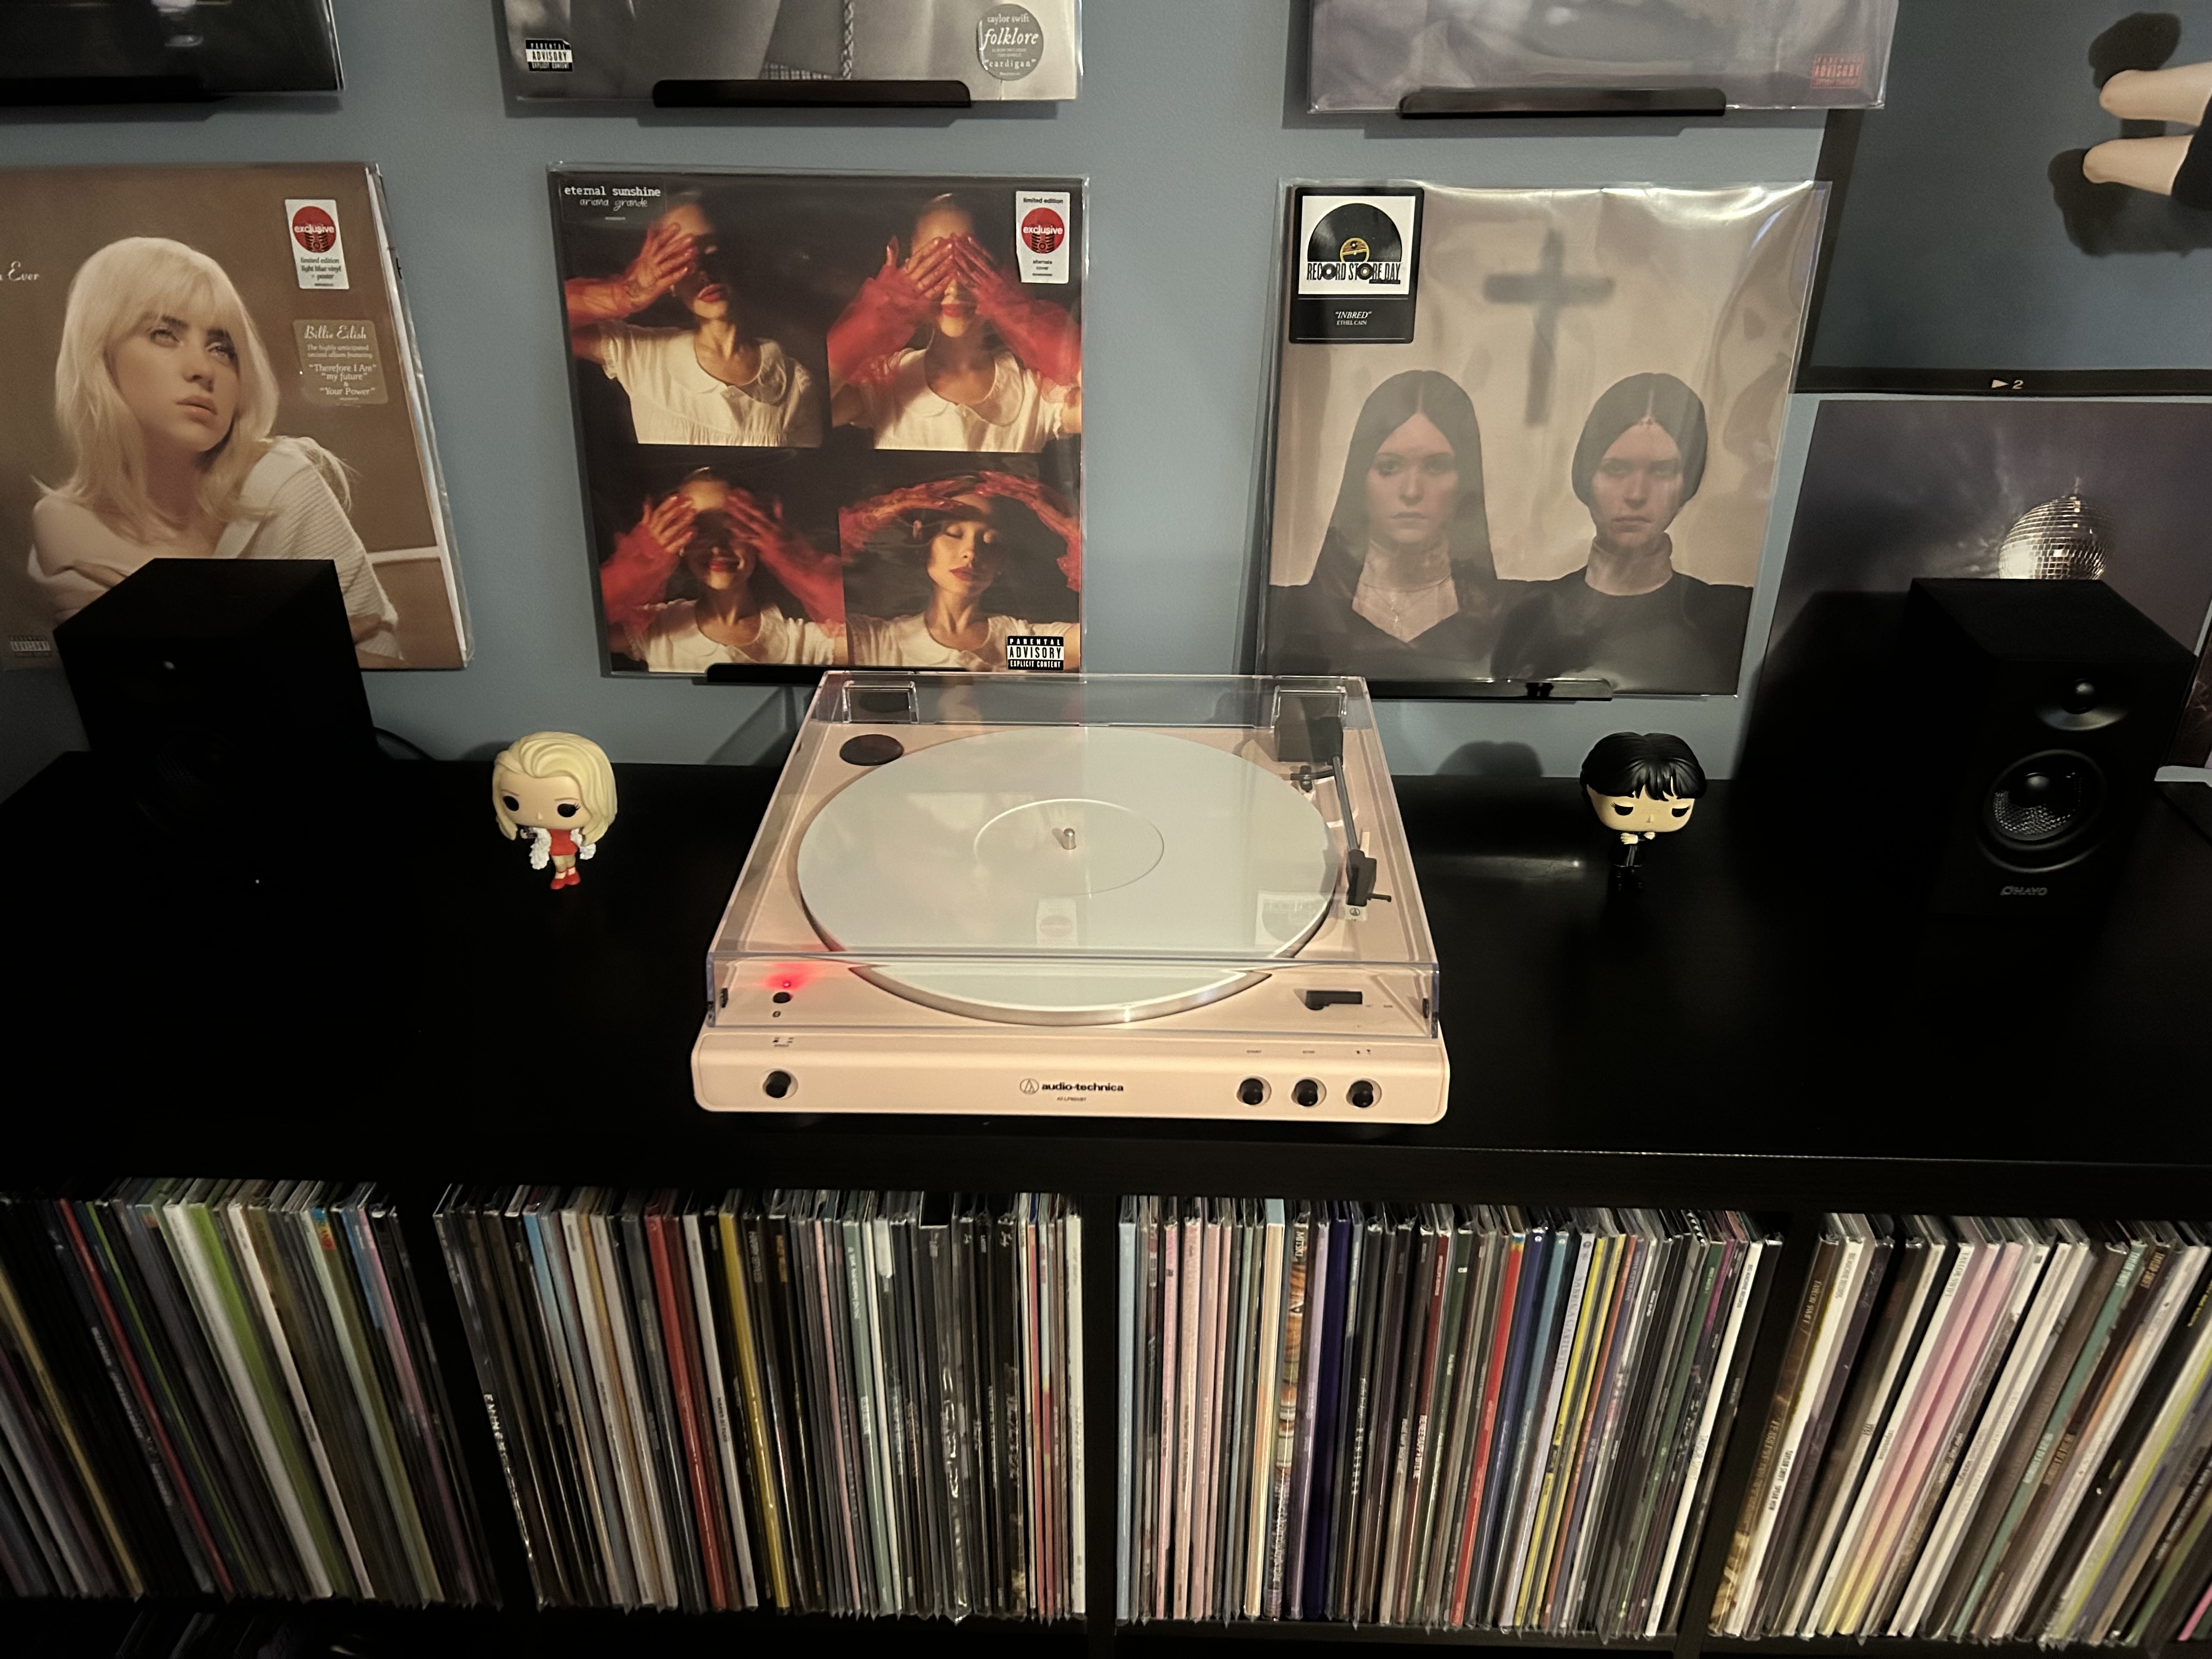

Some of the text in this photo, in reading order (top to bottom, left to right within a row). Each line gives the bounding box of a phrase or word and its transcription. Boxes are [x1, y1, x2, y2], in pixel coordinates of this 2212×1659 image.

[988, 13, 1029, 25] taylor swift
[979, 27, 1039, 50] folklore
[532, 50, 566, 61] ADVISORY
[565, 186, 661, 196] eternal sunshine
[613, 198, 648, 212] grande
[294, 224, 335, 234] exclusive
[1023, 225, 1063, 234] exclusive
[8, 261, 39, 281] Ever
[1307, 263, 1346, 280] RECORD
[1384, 263, 1401, 280] DAY
[304, 325, 366, 339] Billie Eilish
[345, 387, 375, 395] Power"
[2012, 380, 2024, 390] 2
[1009, 646, 1061, 659] ADVISORY
[1042, 1082, 1124, 1092] audio-technica
[1295, 1237, 1304, 1257] MITSKI
